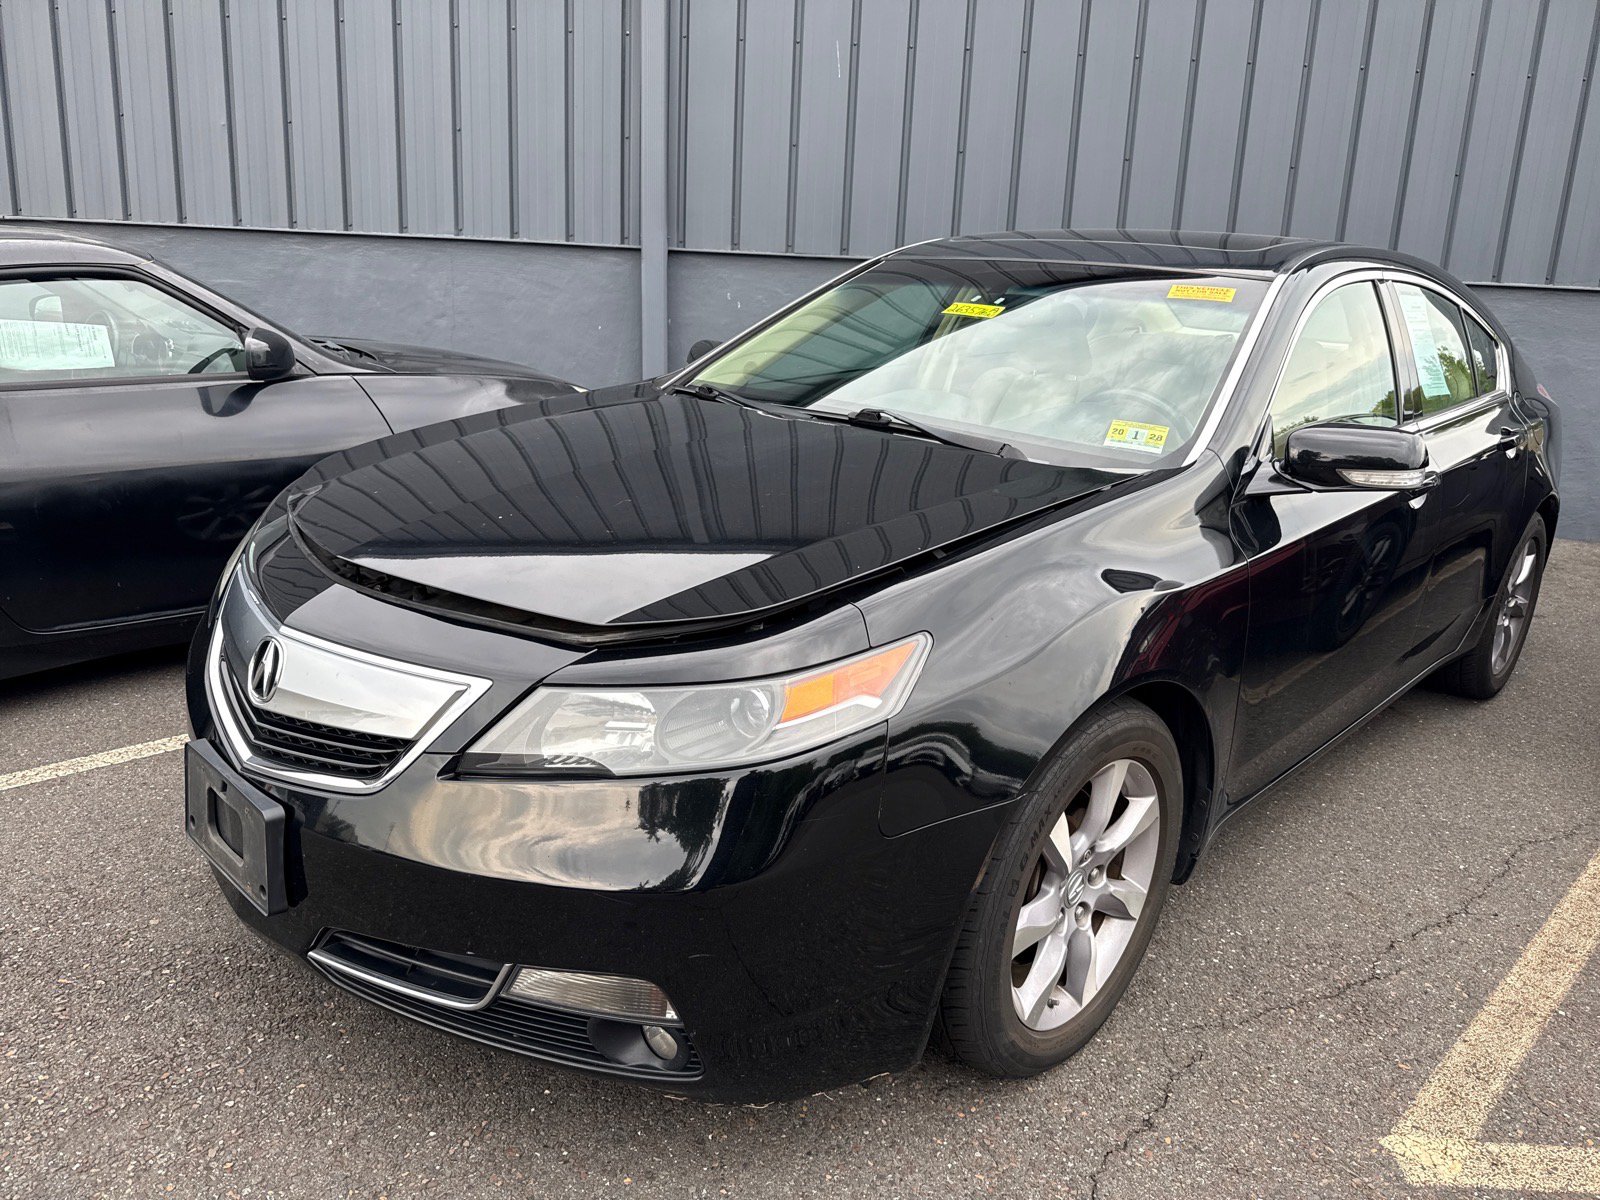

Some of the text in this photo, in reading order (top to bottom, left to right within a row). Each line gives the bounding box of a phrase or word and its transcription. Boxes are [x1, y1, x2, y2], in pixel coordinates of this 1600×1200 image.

[1111, 427, 1163, 442] 20 1 28
